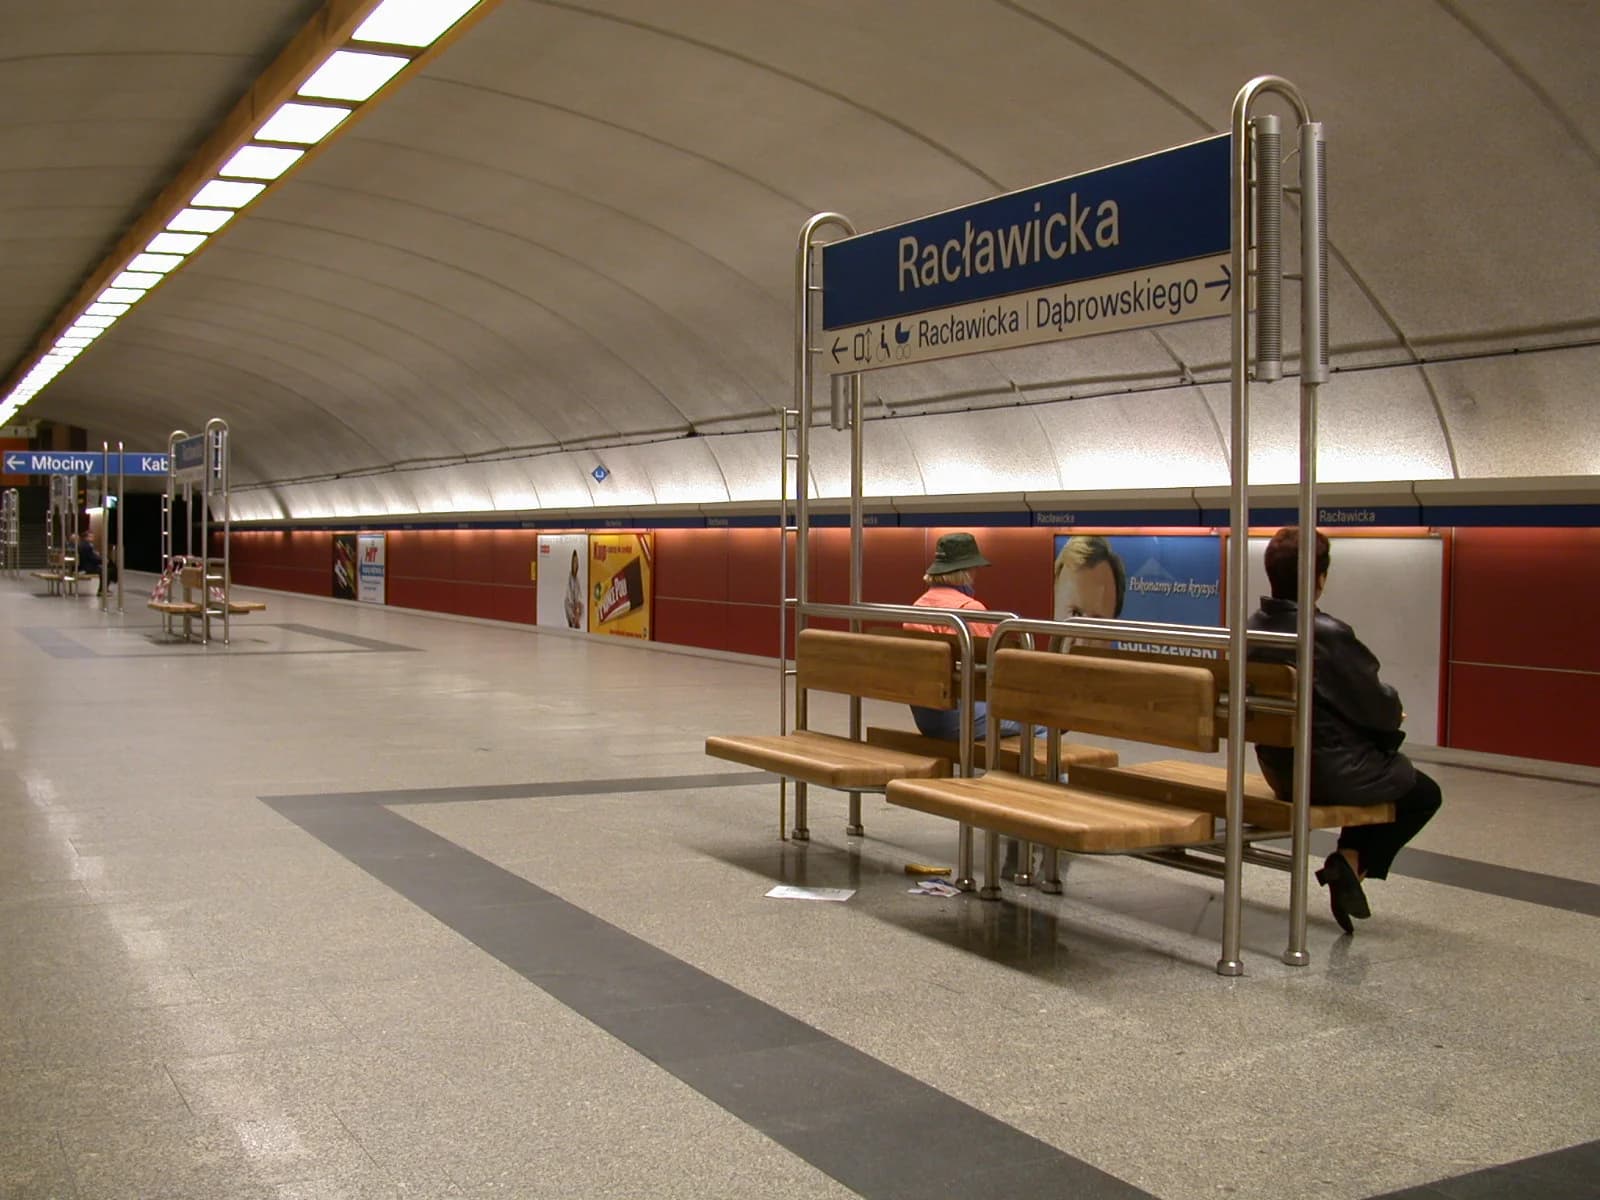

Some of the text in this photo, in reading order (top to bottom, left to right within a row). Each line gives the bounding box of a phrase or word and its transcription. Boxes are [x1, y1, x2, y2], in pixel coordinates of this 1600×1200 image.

[898, 193, 1119, 292] Racławicka
[918, 278, 1198, 348] Racławicka Dąbrowskiego
[32, 455, 169, 473] Młociny Kab
[1037, 512, 1075, 524] Racławicka
[1319, 509, 1375, 523] Racławicka
[1129, 576, 1171, 596] Pokonamy
